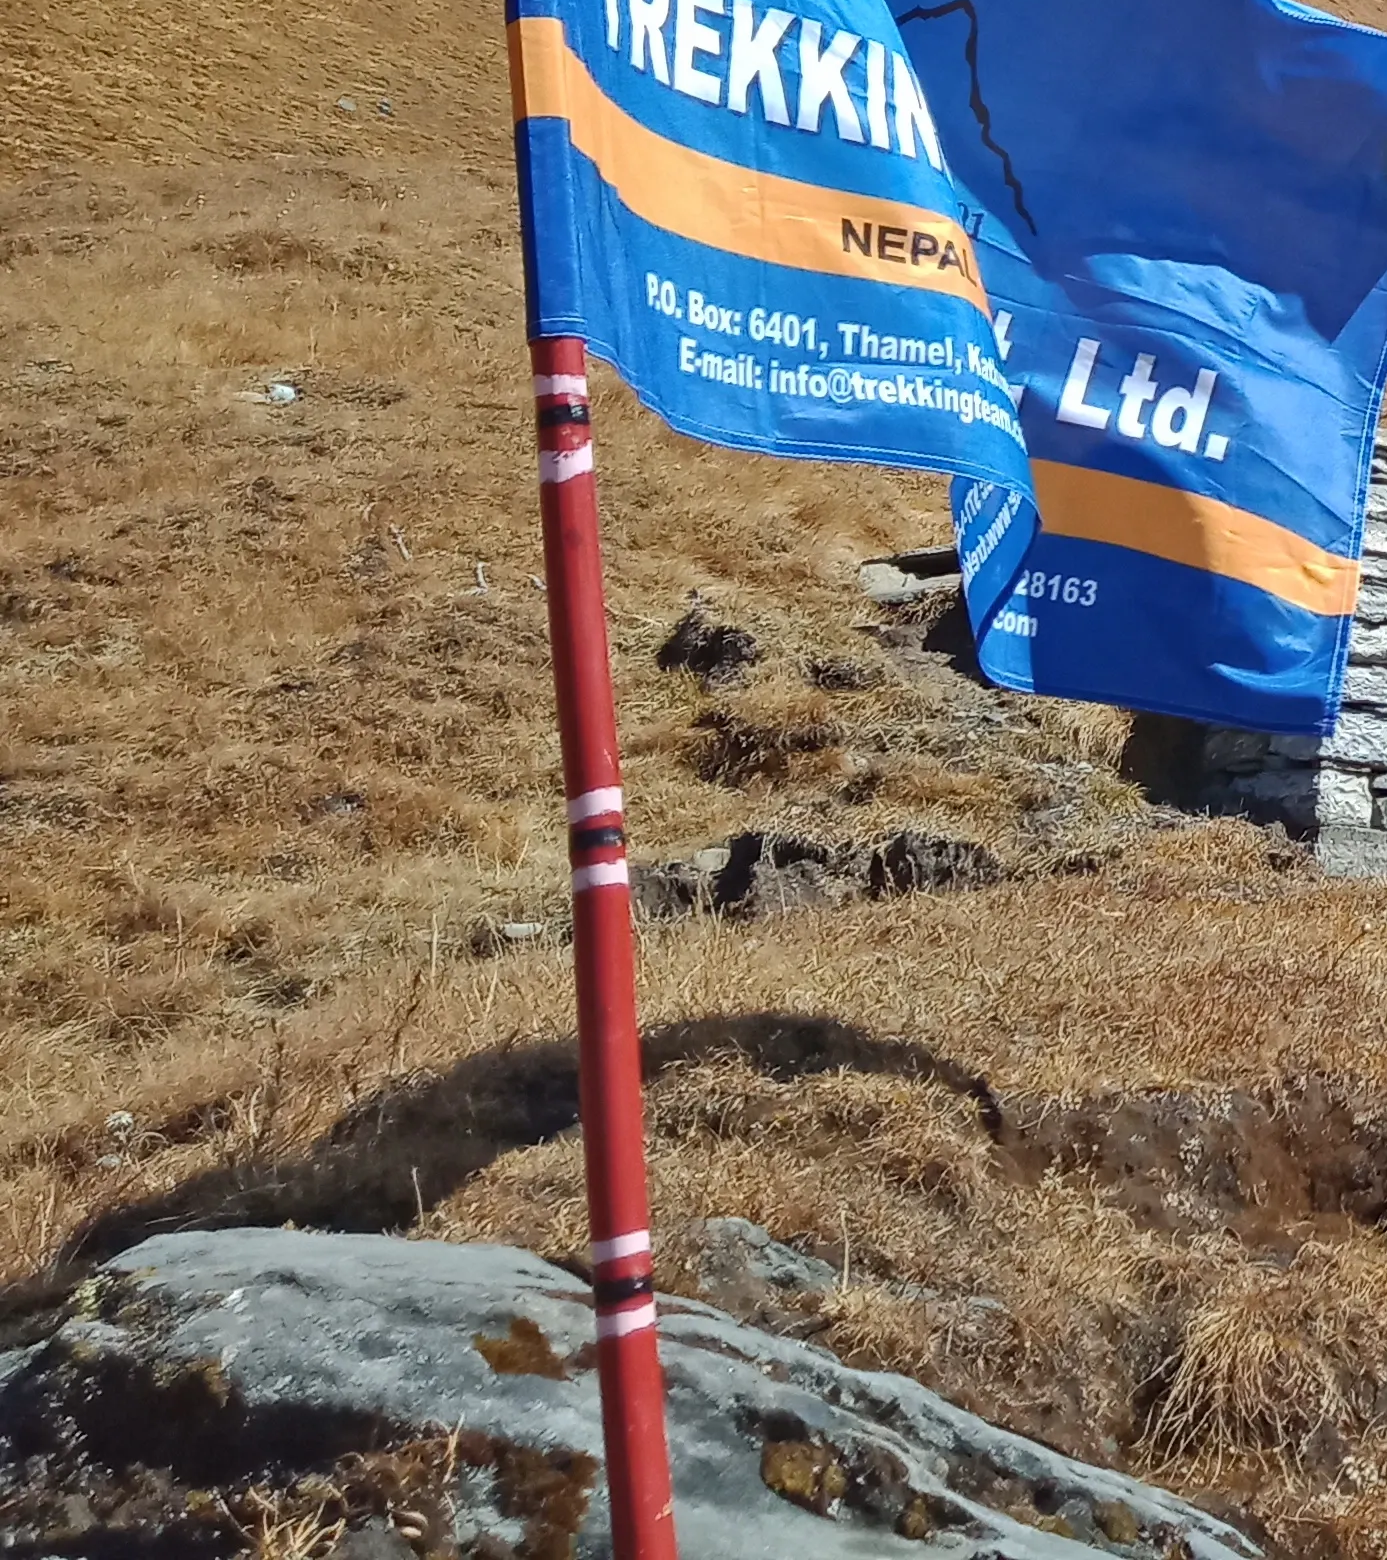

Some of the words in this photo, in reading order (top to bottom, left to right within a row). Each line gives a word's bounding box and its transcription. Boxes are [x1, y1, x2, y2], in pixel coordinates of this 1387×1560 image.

[841, 217, 978, 288] NEPAL
[646, 272, 683, 319] P.O.
[687, 289, 743, 336] Box:
[749, 307, 829, 361] 6401,
[838, 321, 962, 375] Thamel,
[679, 336, 764, 390] E-mail:
[1055, 336, 1230, 462] Ltd.
